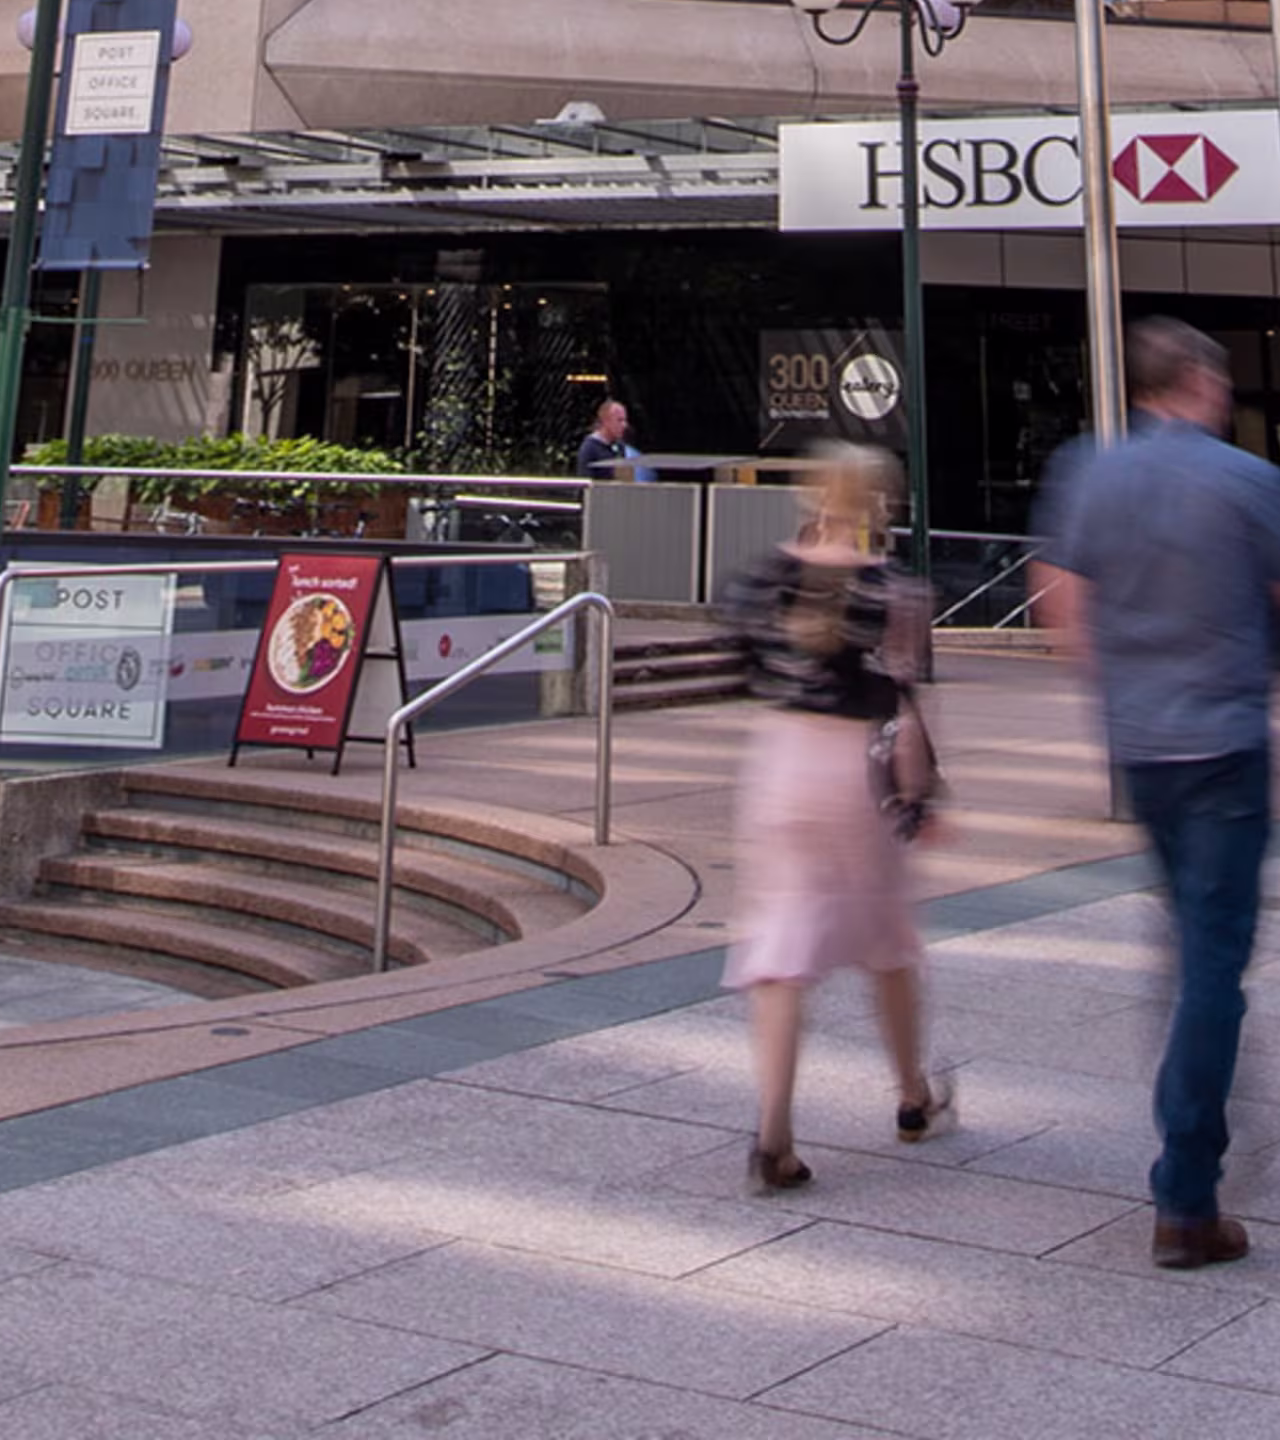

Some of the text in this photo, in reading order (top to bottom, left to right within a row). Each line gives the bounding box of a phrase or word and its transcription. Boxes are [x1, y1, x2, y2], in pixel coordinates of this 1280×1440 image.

[97, 46, 134, 59] POST
[857, 135, 1084, 210] HSBC
[769, 353, 829, 391] 300
[769, 393, 829, 410] QUEEN
[56, 588, 125, 610] POST
[28, 696, 132, 720] SQUARE
